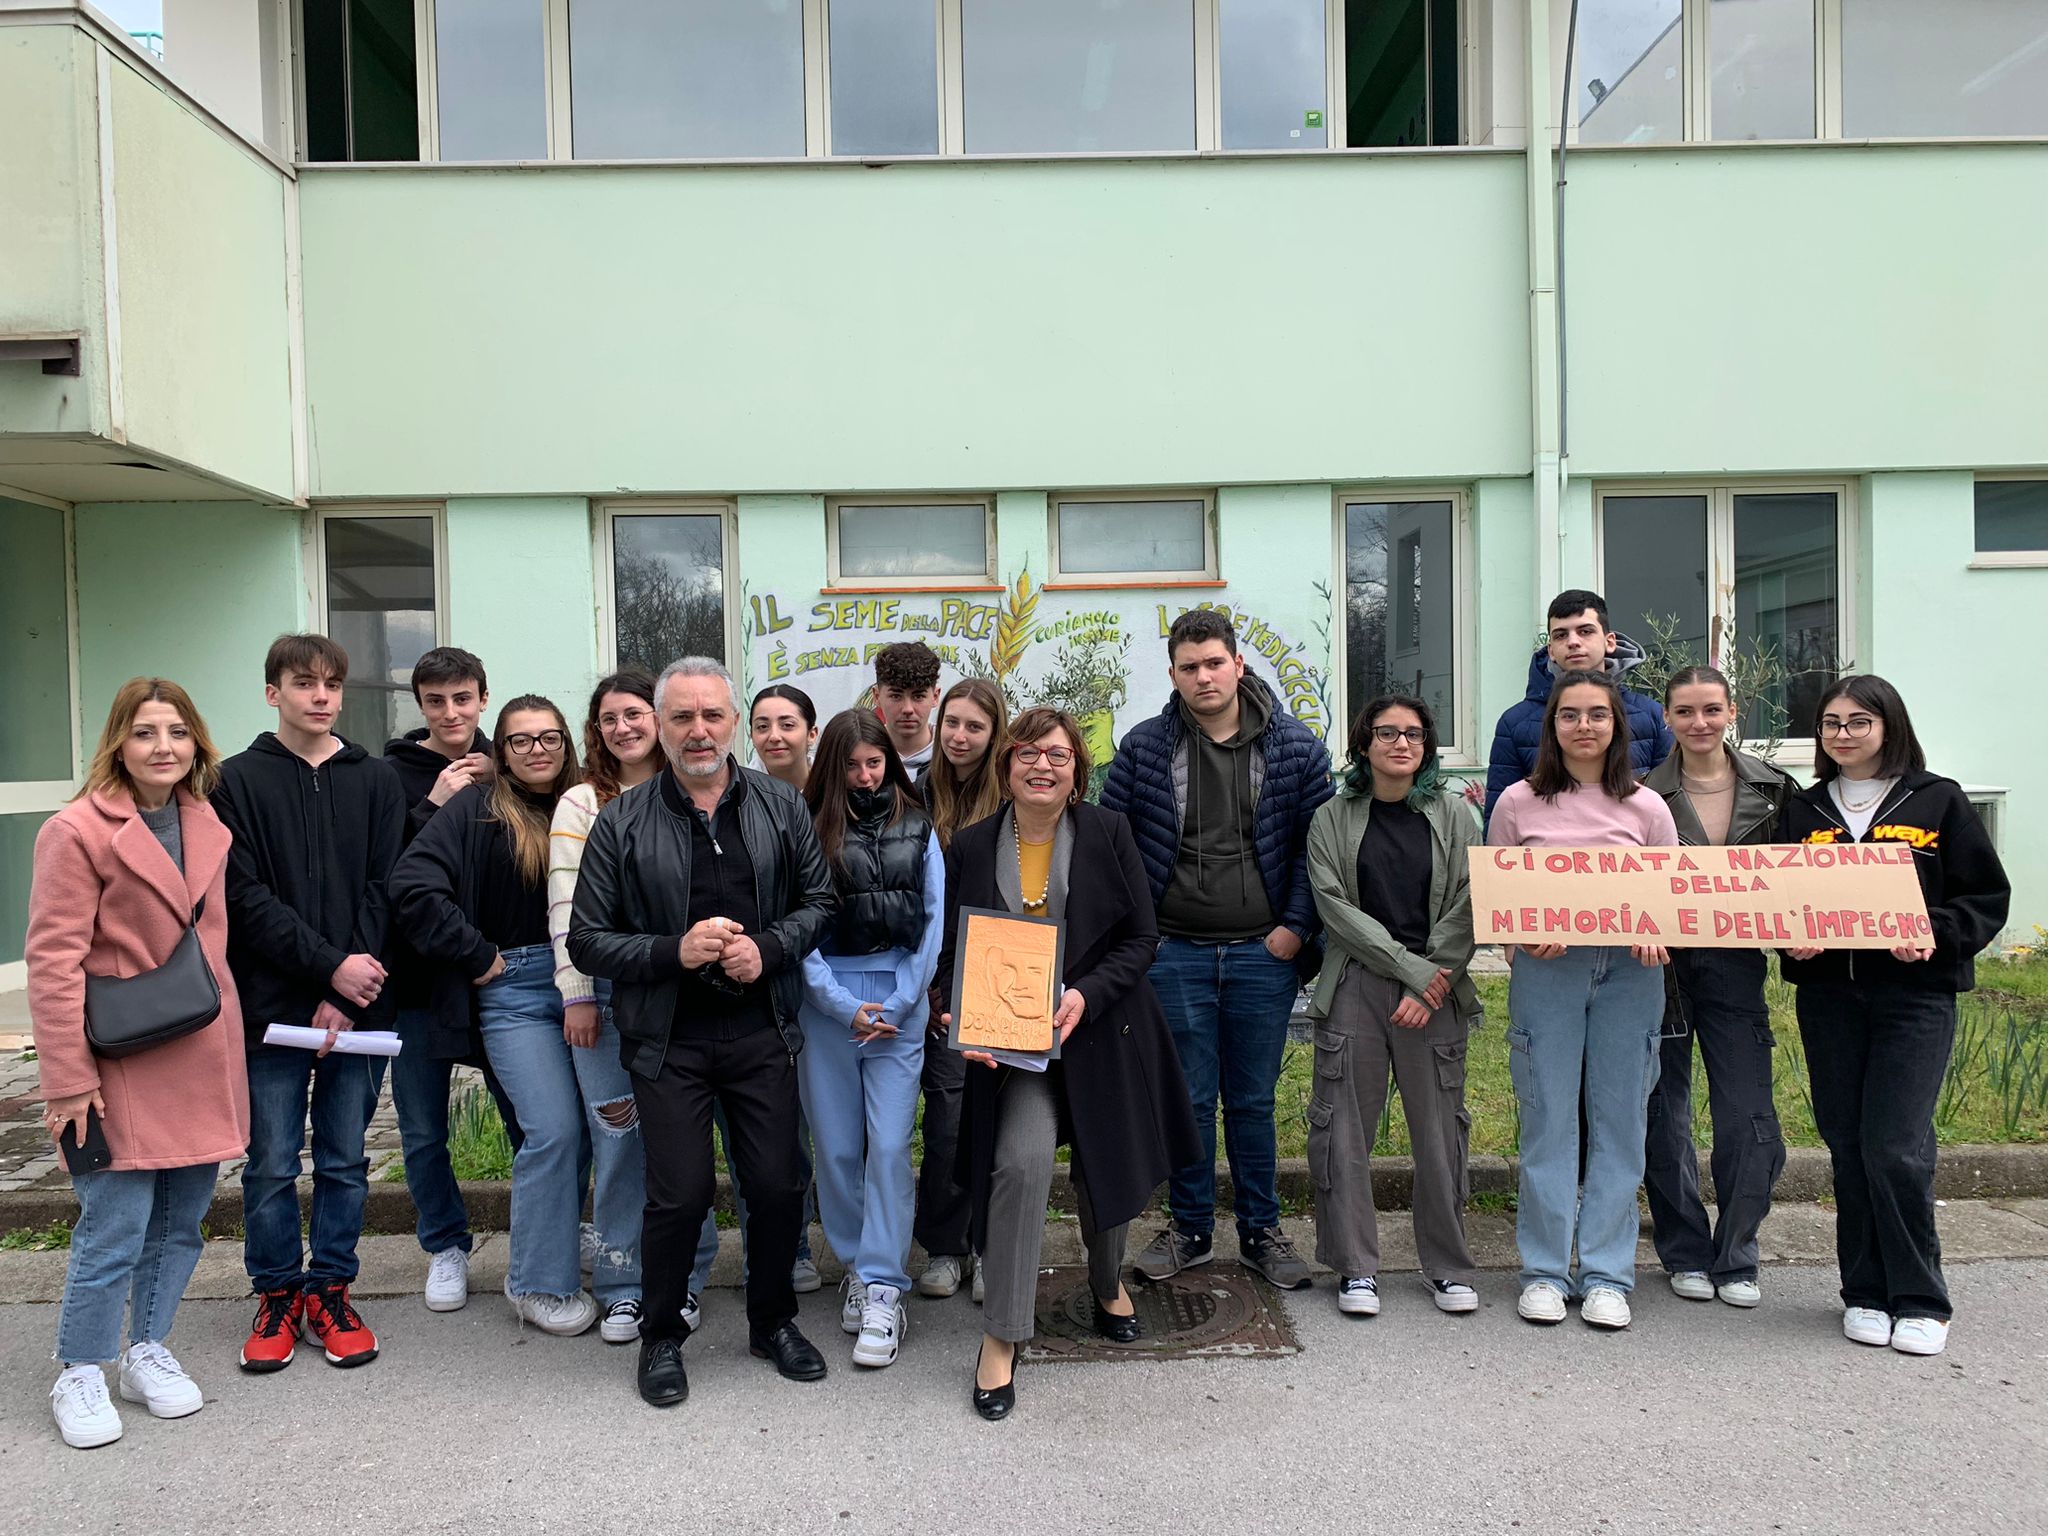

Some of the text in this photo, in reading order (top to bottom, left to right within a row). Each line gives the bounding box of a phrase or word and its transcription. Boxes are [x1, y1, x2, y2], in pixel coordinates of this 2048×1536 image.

[750, 595, 1000, 641] IL SEME DELLA PACE
[795, 647, 859, 675] SENZA
[1671, 875, 1770, 894] DELLA
[1678, 908, 1699, 934] E
